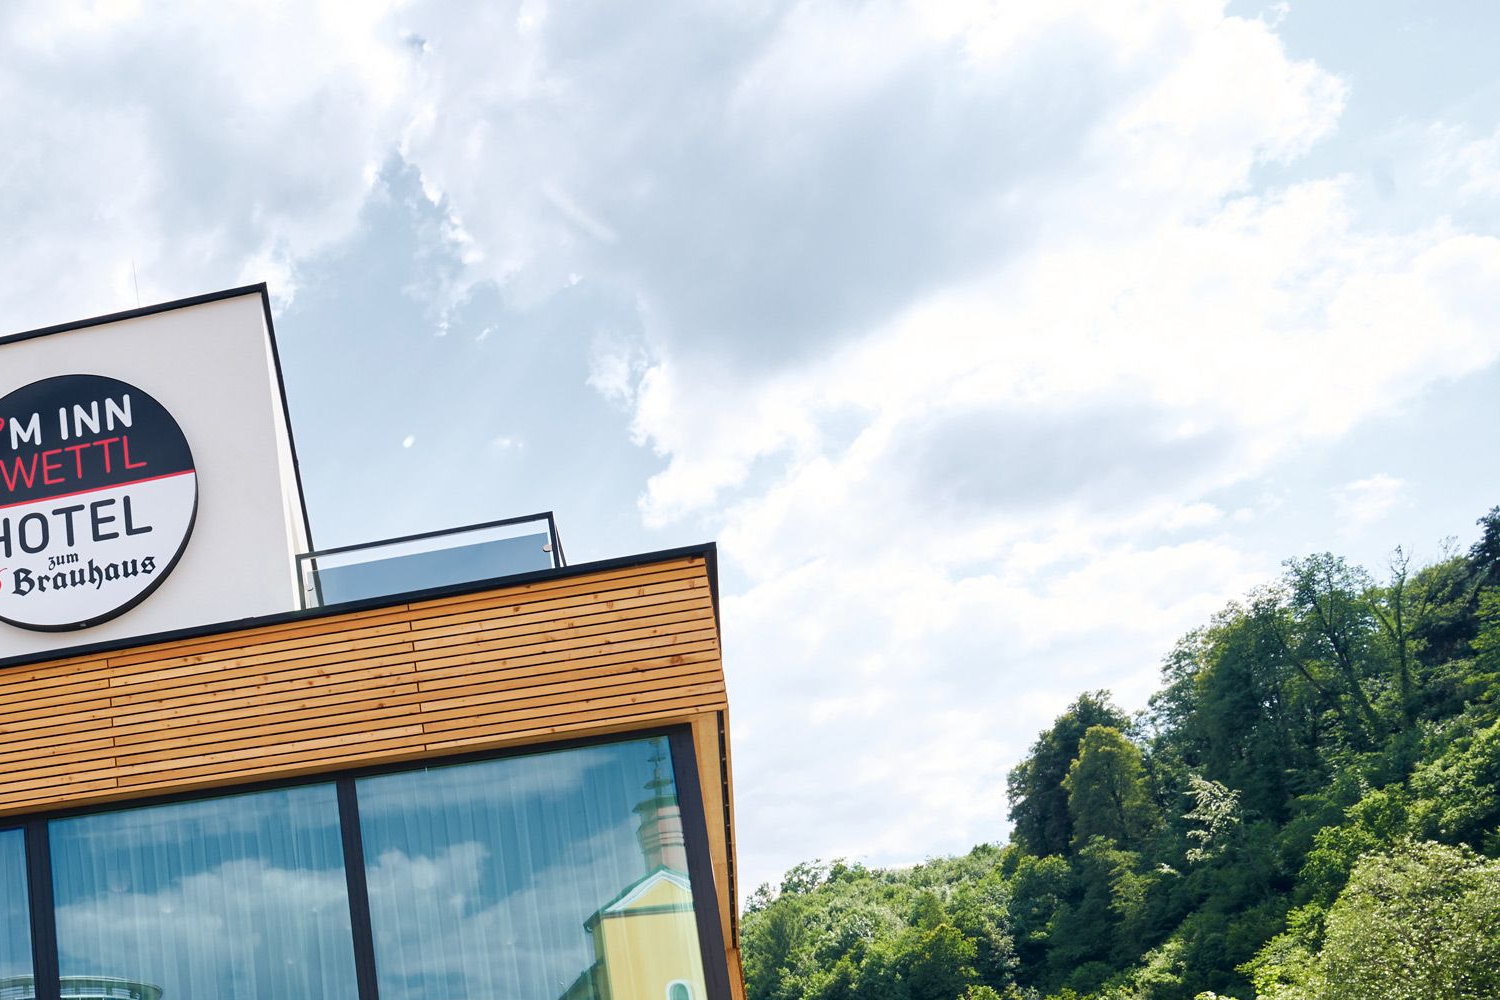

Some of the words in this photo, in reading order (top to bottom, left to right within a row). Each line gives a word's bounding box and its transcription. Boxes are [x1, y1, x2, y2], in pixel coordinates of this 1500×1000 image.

[59, 394, 132, 440] INN
[12, 556, 156, 596] Brauhaus
[48, 553, 79, 571] zum
